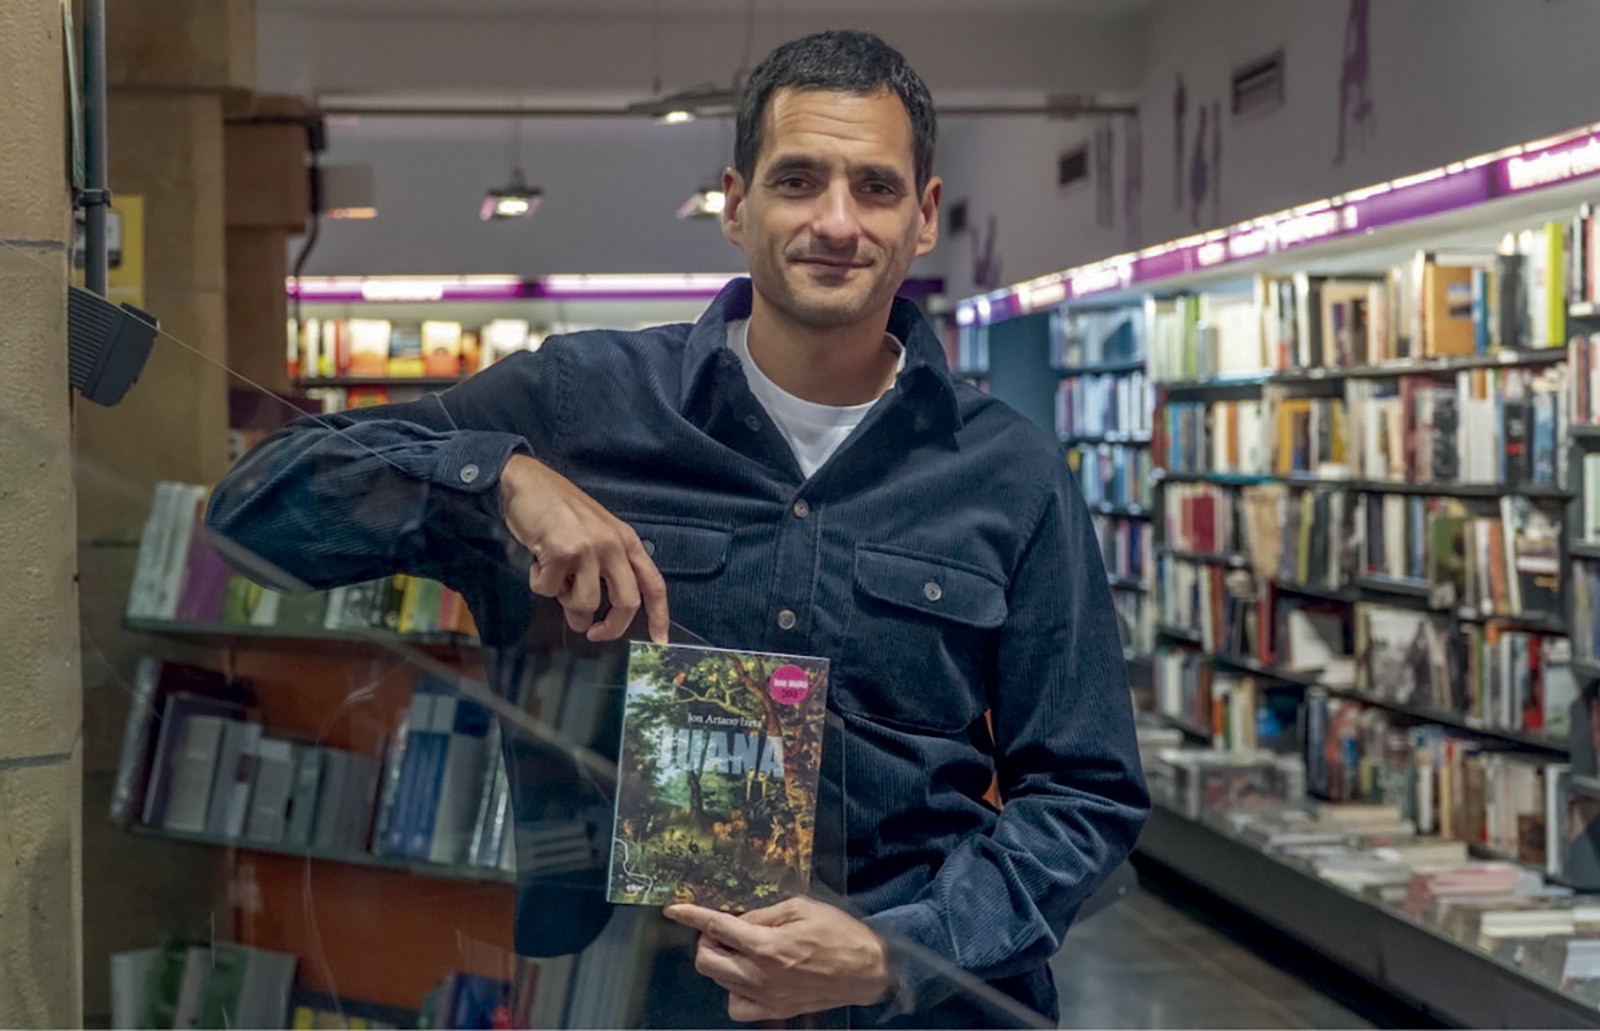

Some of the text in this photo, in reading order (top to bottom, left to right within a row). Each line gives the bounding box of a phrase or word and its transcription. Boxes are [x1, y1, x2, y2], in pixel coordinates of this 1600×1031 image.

[687, 712, 704, 724] Jon
[705, 714, 739, 726] Artano
[656, 728, 785, 778] JUANA
